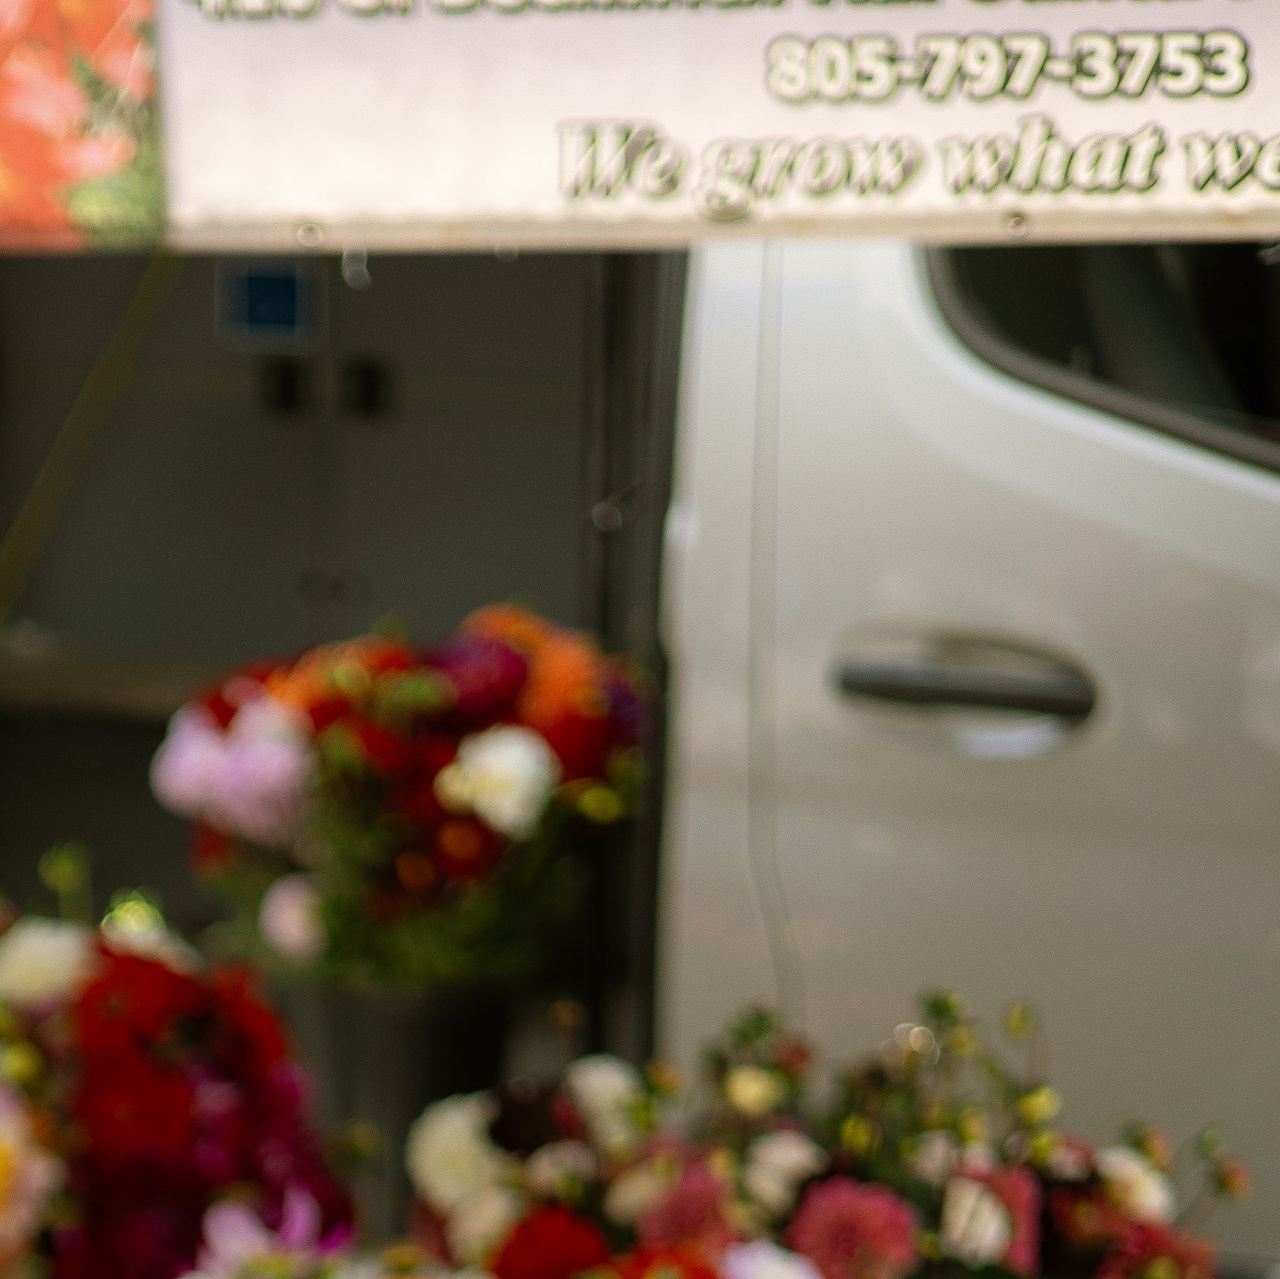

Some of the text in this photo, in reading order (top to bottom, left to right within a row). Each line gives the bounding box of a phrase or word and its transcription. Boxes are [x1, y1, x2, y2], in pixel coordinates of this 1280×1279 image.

[767, 31, 1252, 102] 805-797-3753
[558, 119, 684, 201] We
[696, 133, 923, 222] grow
[939, 114, 1166, 194] what
